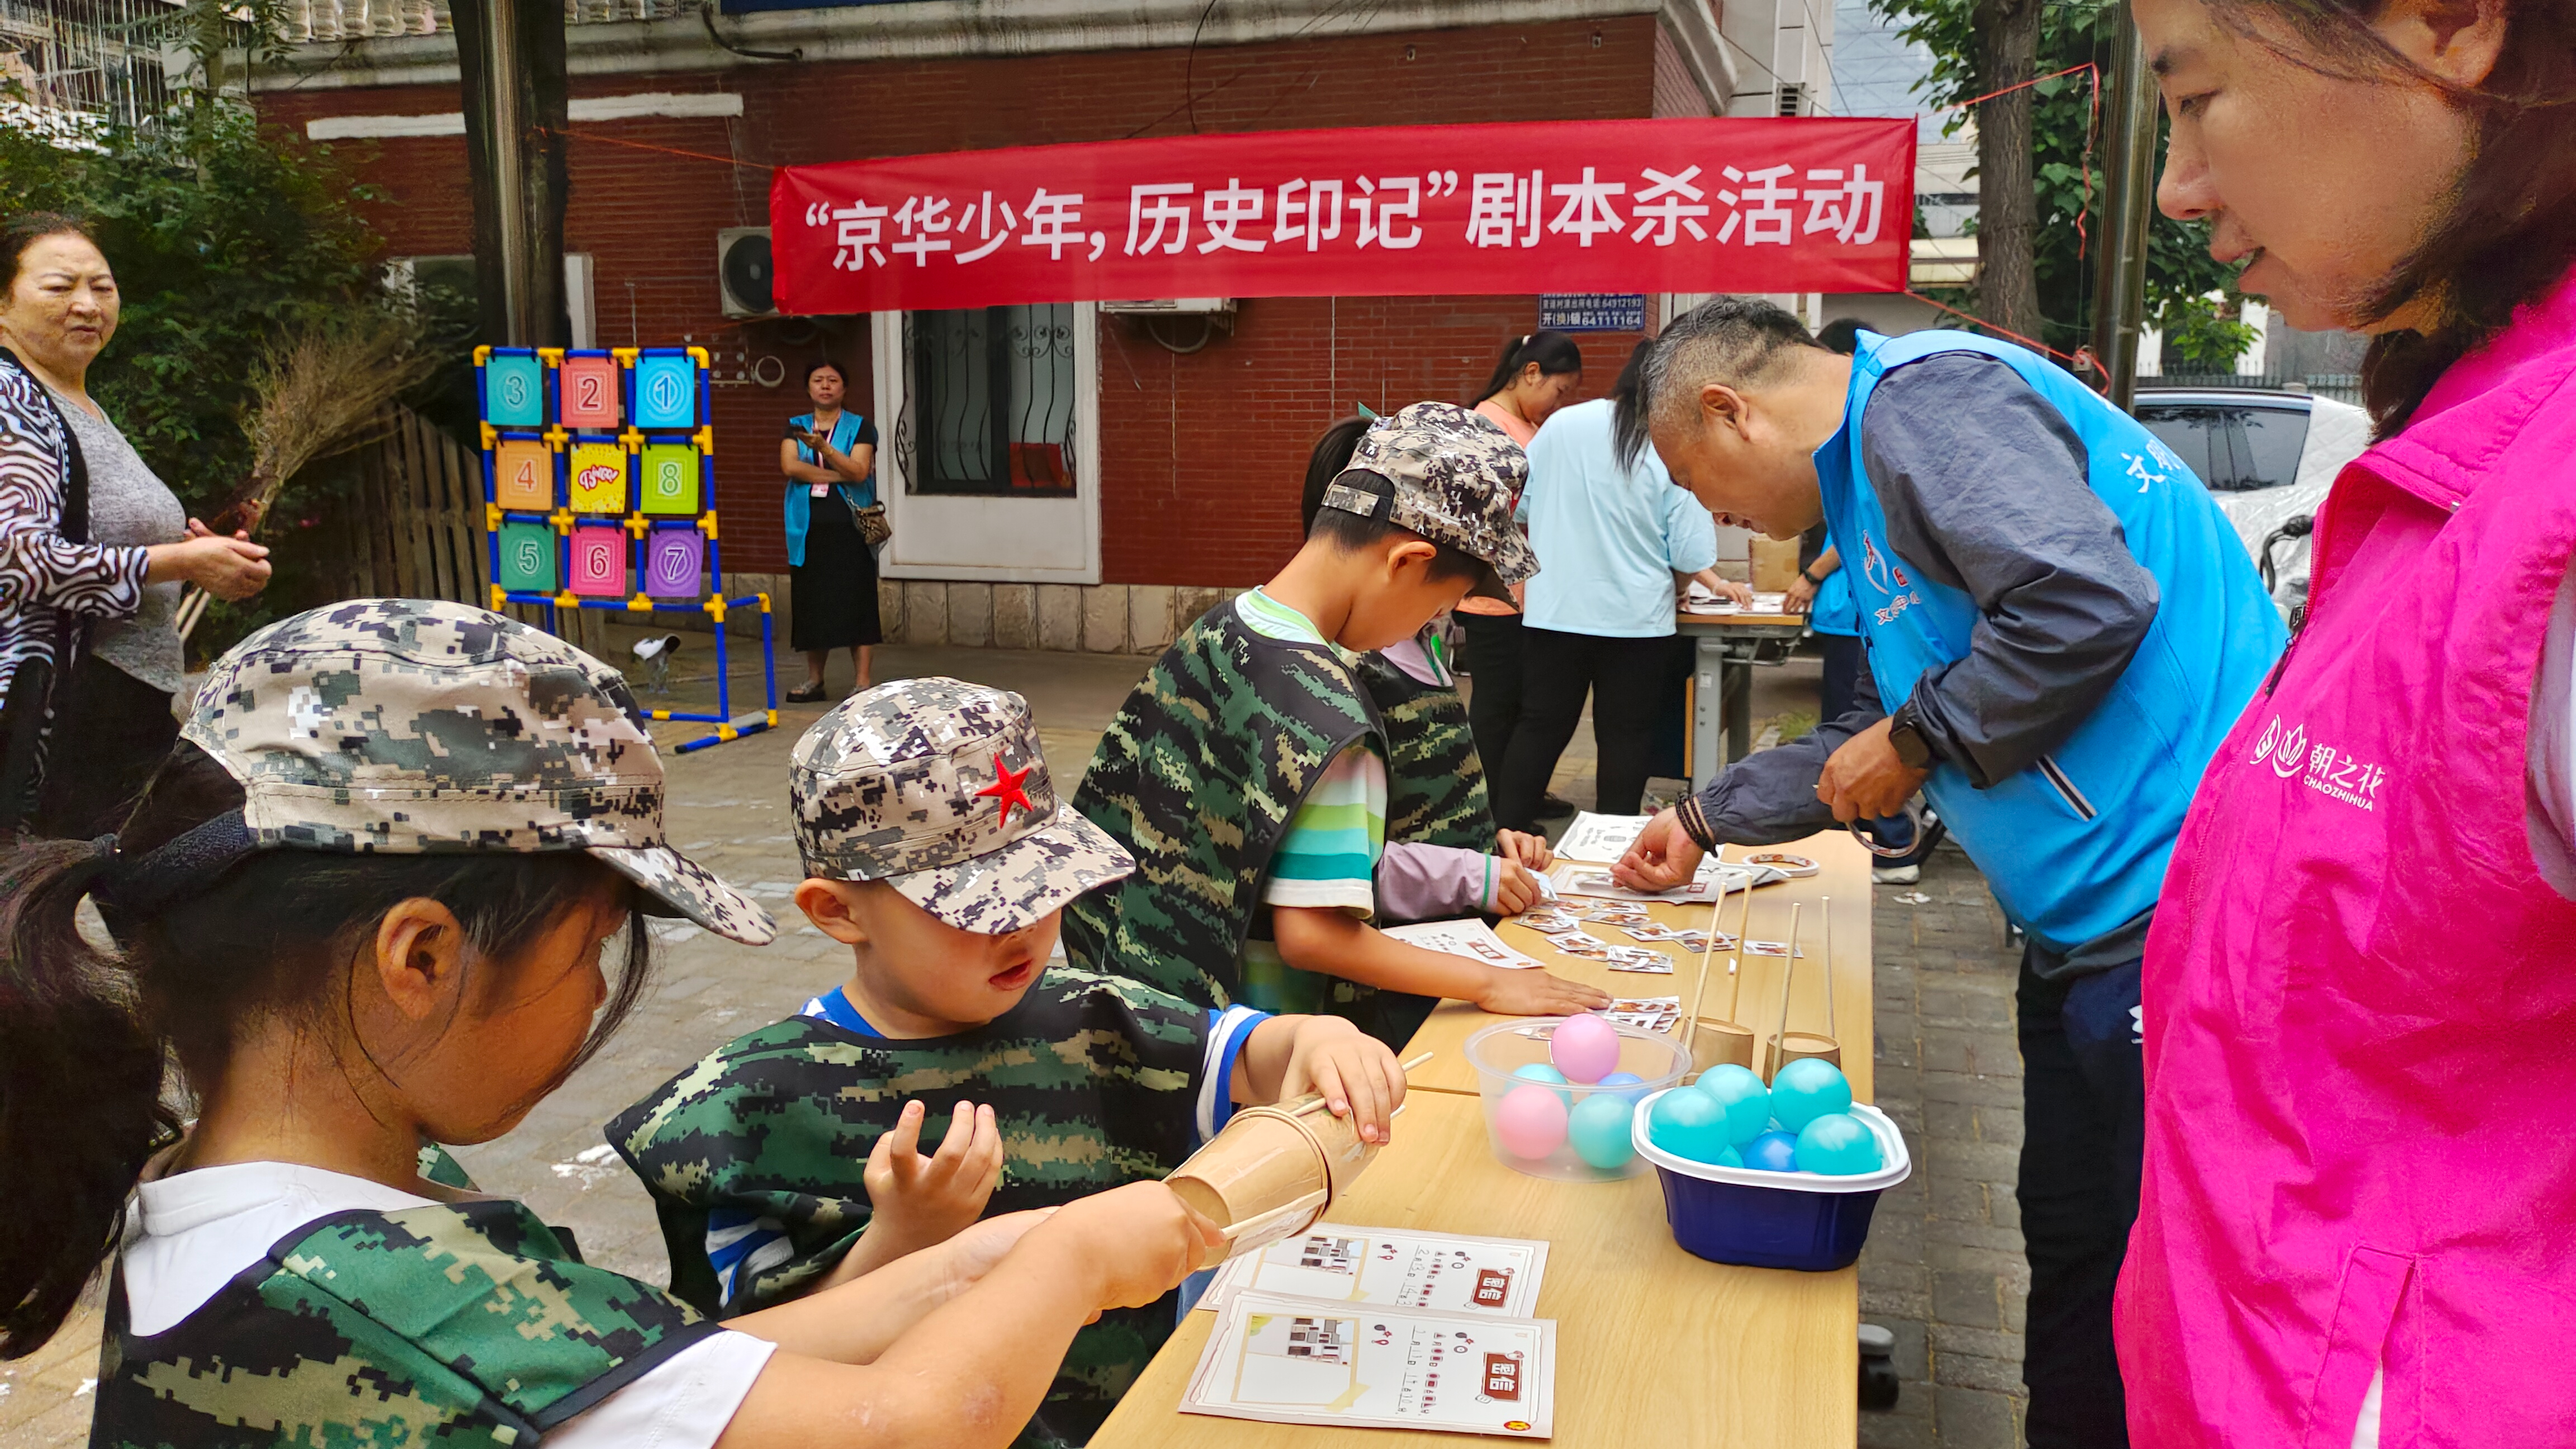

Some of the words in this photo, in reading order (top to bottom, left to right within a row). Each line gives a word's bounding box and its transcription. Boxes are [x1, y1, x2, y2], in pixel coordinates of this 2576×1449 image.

[506, 375, 525, 408] 3
[579, 376, 601, 410] 2
[654, 375, 671, 410] 1
[515, 460, 536, 492] 4
[660, 463, 680, 496] 8
[518, 540, 539, 575] 5
[590, 546, 609, 579] 6
[665, 547, 686, 580] 7
[2303, 774, 2374, 812] CHAOZHIHUA
[1489, 1362, 1516, 1392] 密信
